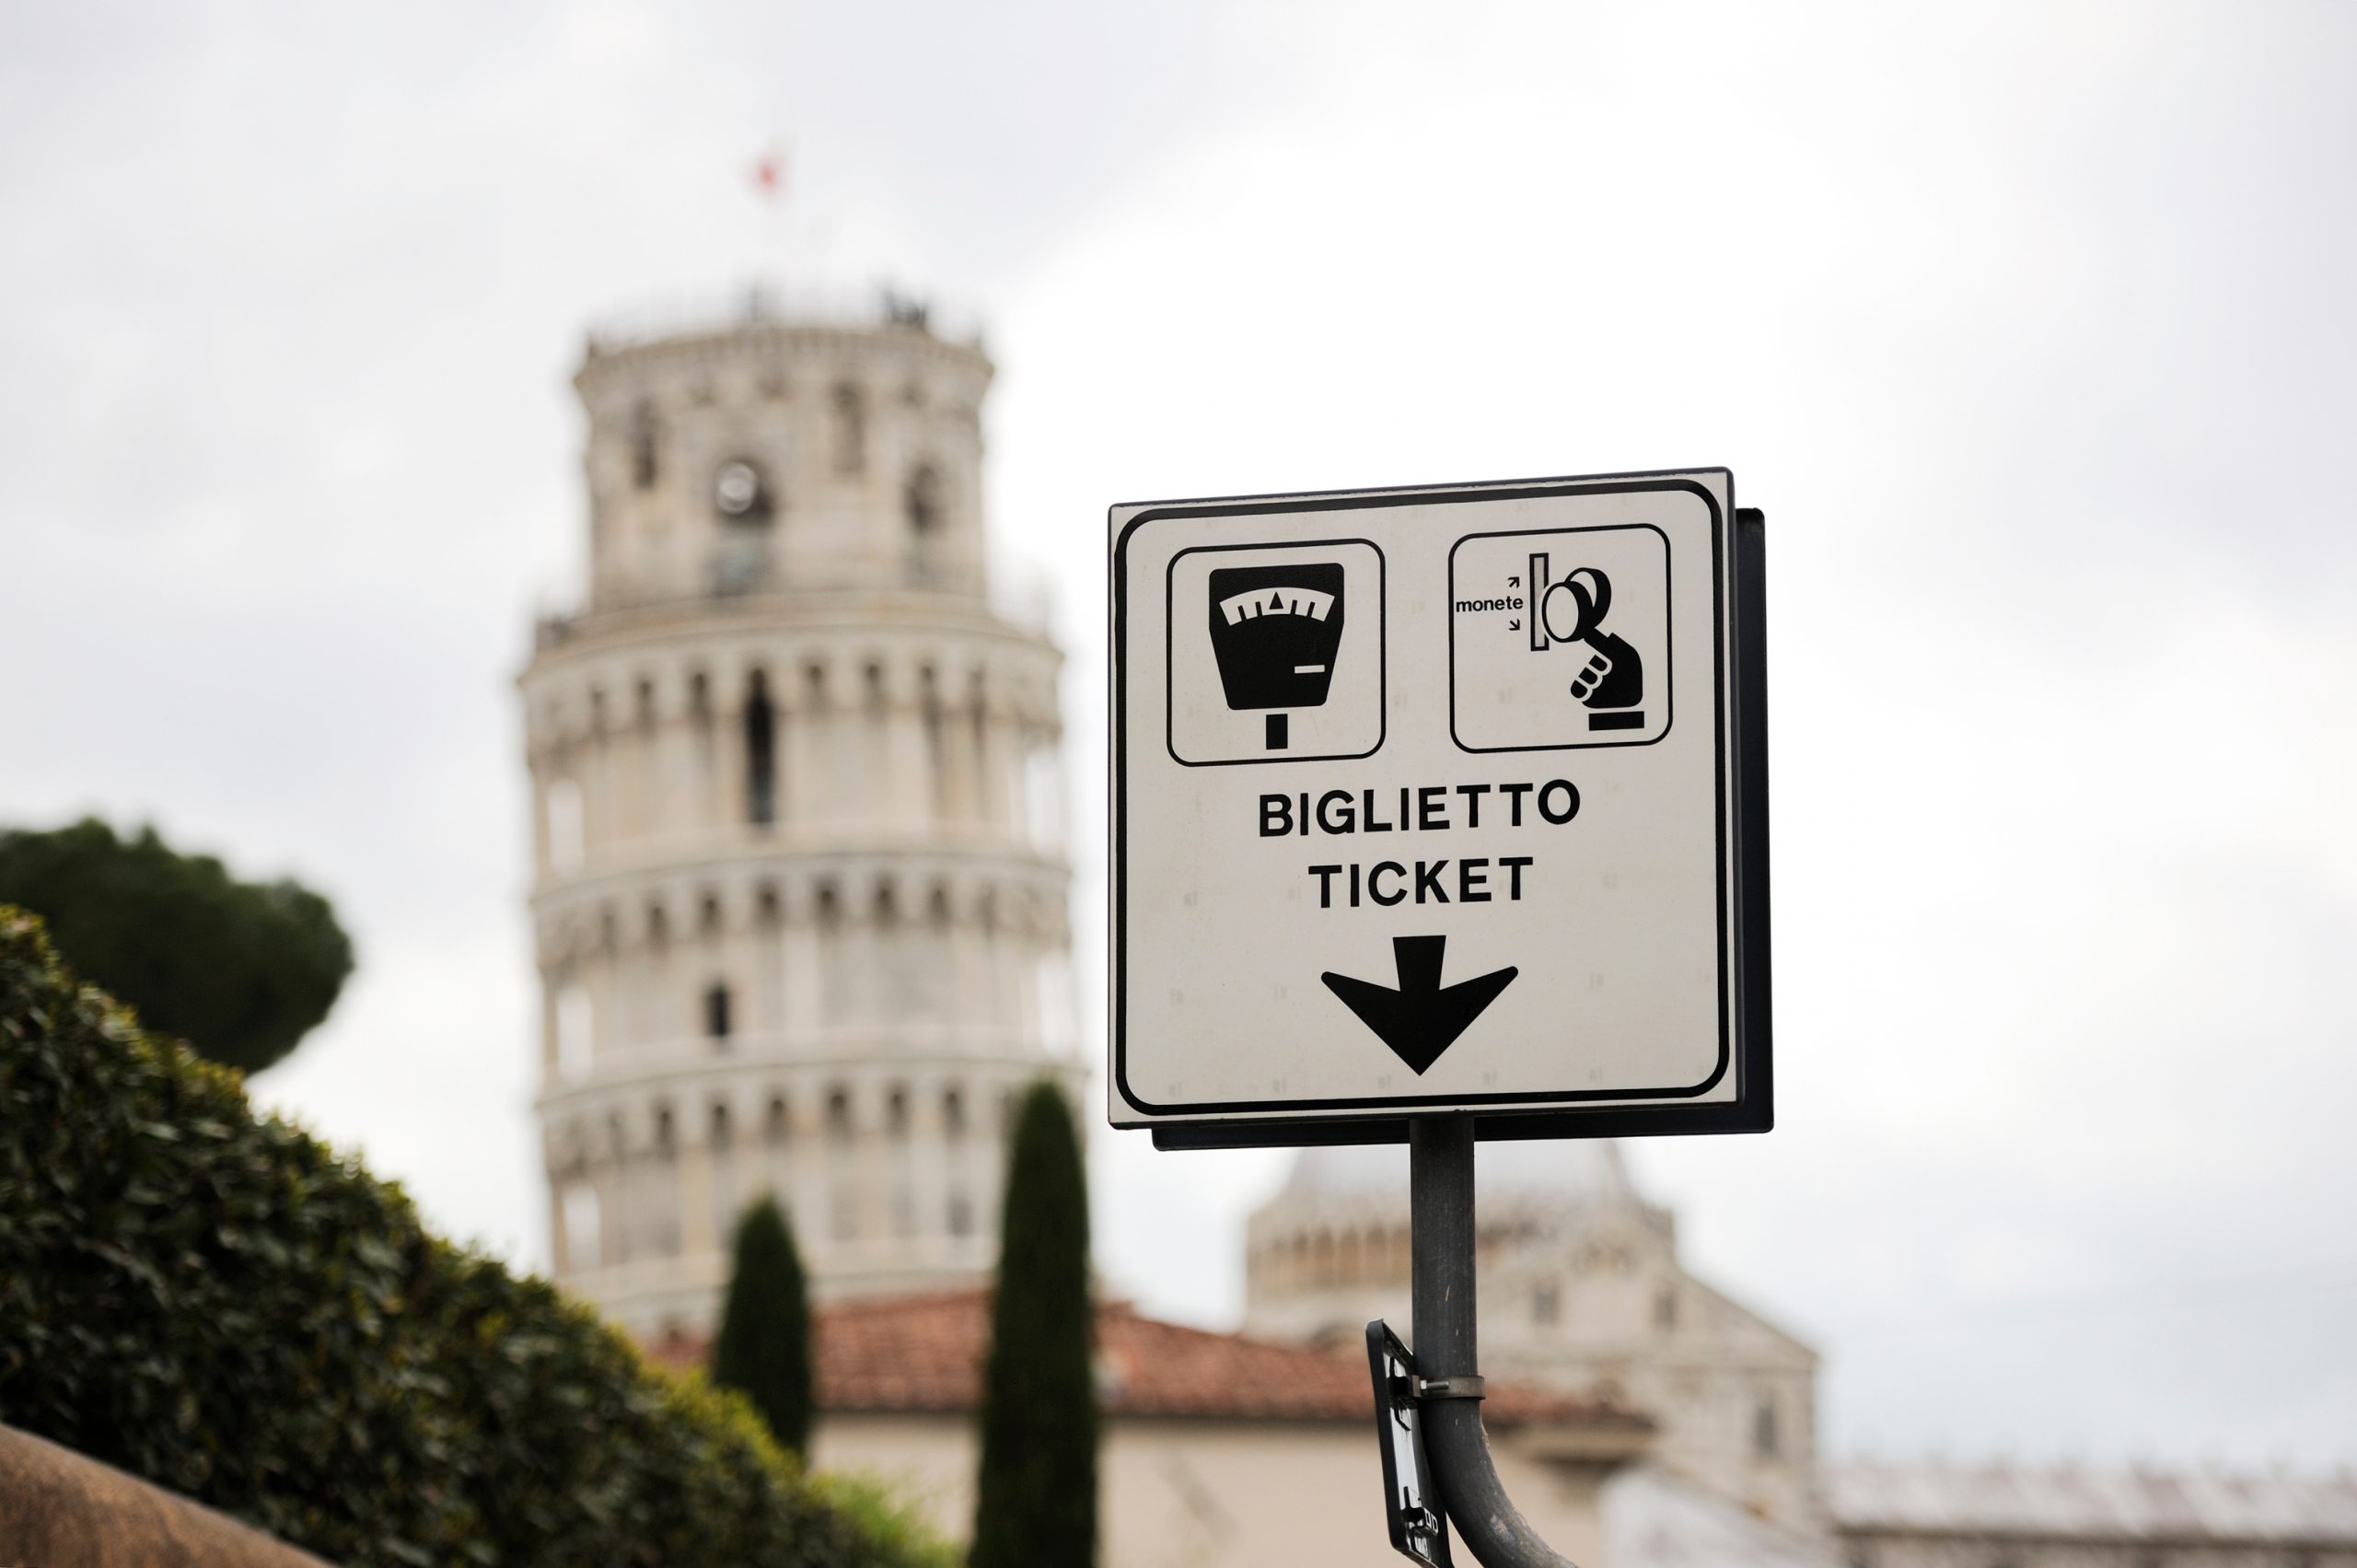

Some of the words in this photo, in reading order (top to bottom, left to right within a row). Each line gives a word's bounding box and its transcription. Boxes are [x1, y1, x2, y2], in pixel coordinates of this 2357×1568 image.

[1455, 595, 1524, 613] monete
[1259, 778, 1581, 838] BIGLIETTO
[1307, 856, 1534, 909] TICKET
